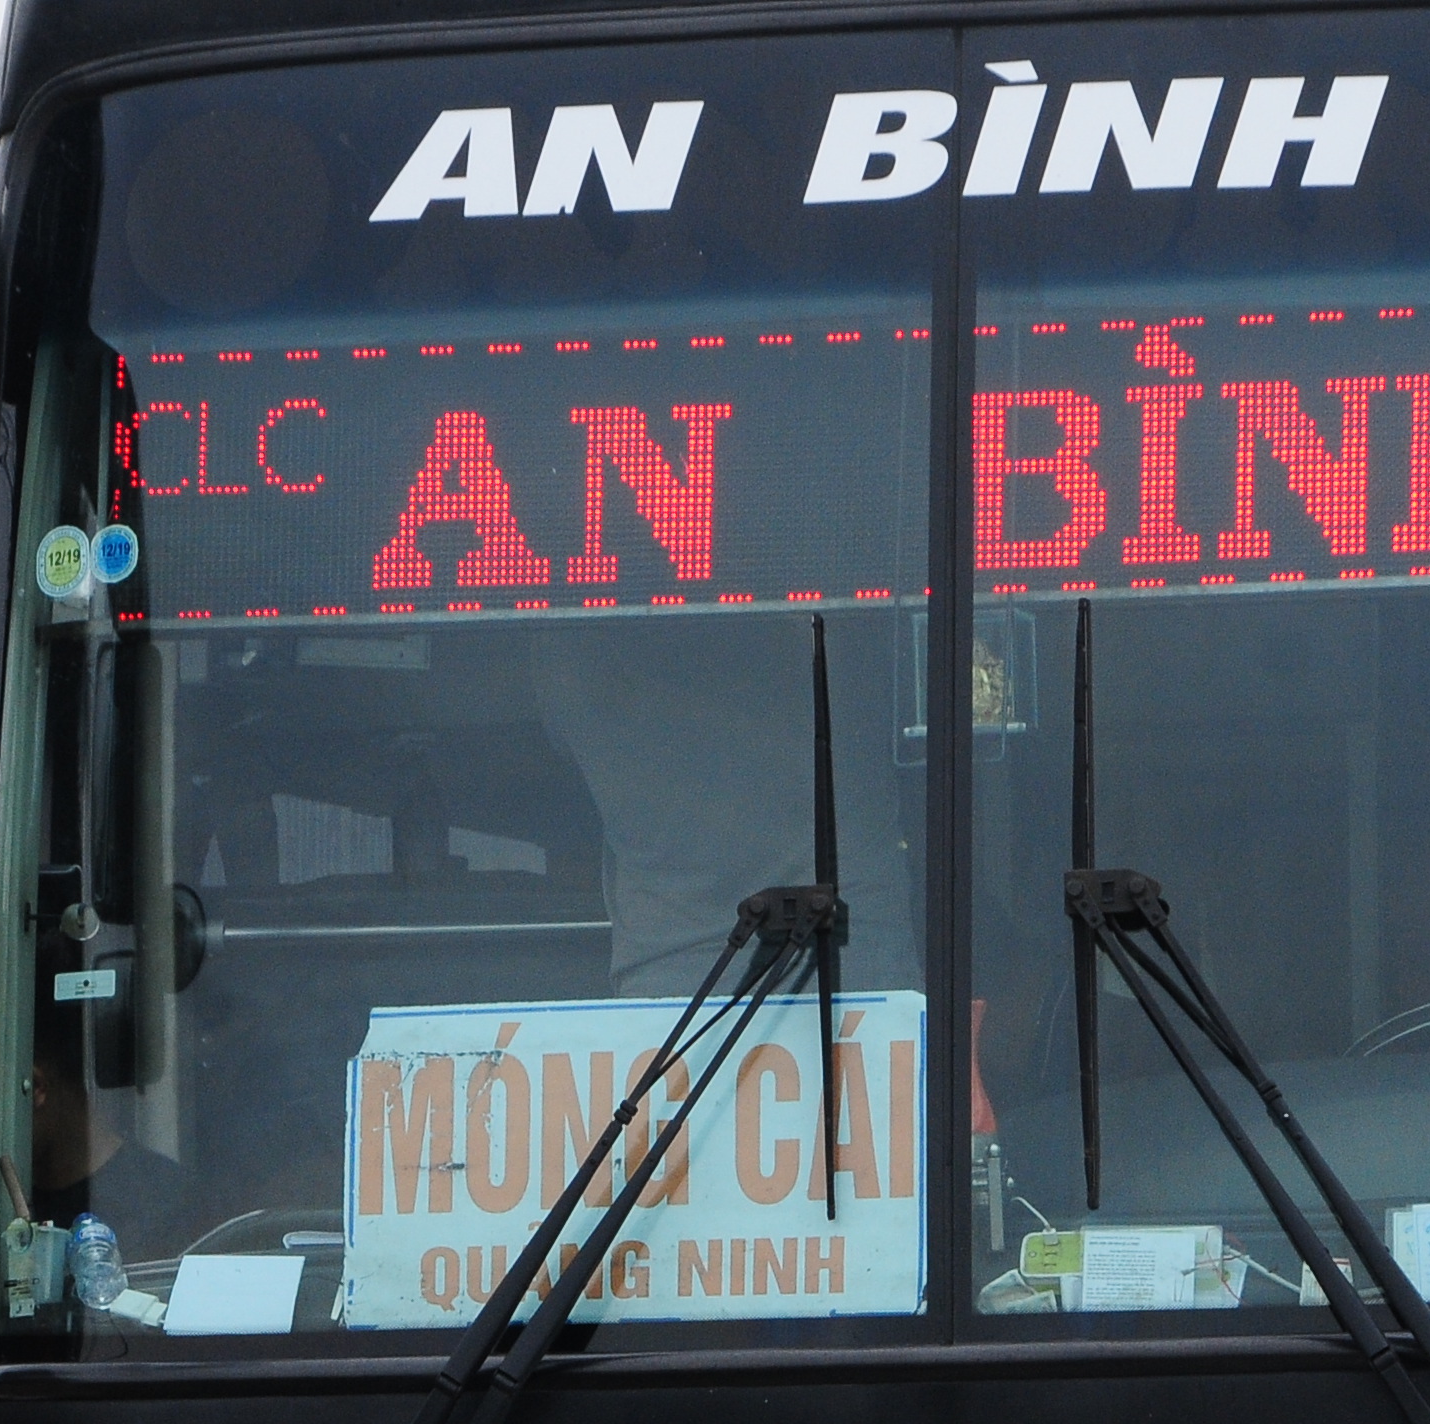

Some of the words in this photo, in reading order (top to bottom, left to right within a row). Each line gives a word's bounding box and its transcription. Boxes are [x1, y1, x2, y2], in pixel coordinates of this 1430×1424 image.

[369, 101, 704, 221] AN
[804, 60, 1389, 203] BÌNH
[102, 542, 131, 557] 12/19
[122, 402, 328, 496] CLC
[372, 403, 734, 591] AN
[48, 548, 81, 567] 12/19
[359, 1022, 690, 1214] MÓNG
[736, 1010, 914, 1205] CÁI
[678, 1236, 844, 1297] NINH
